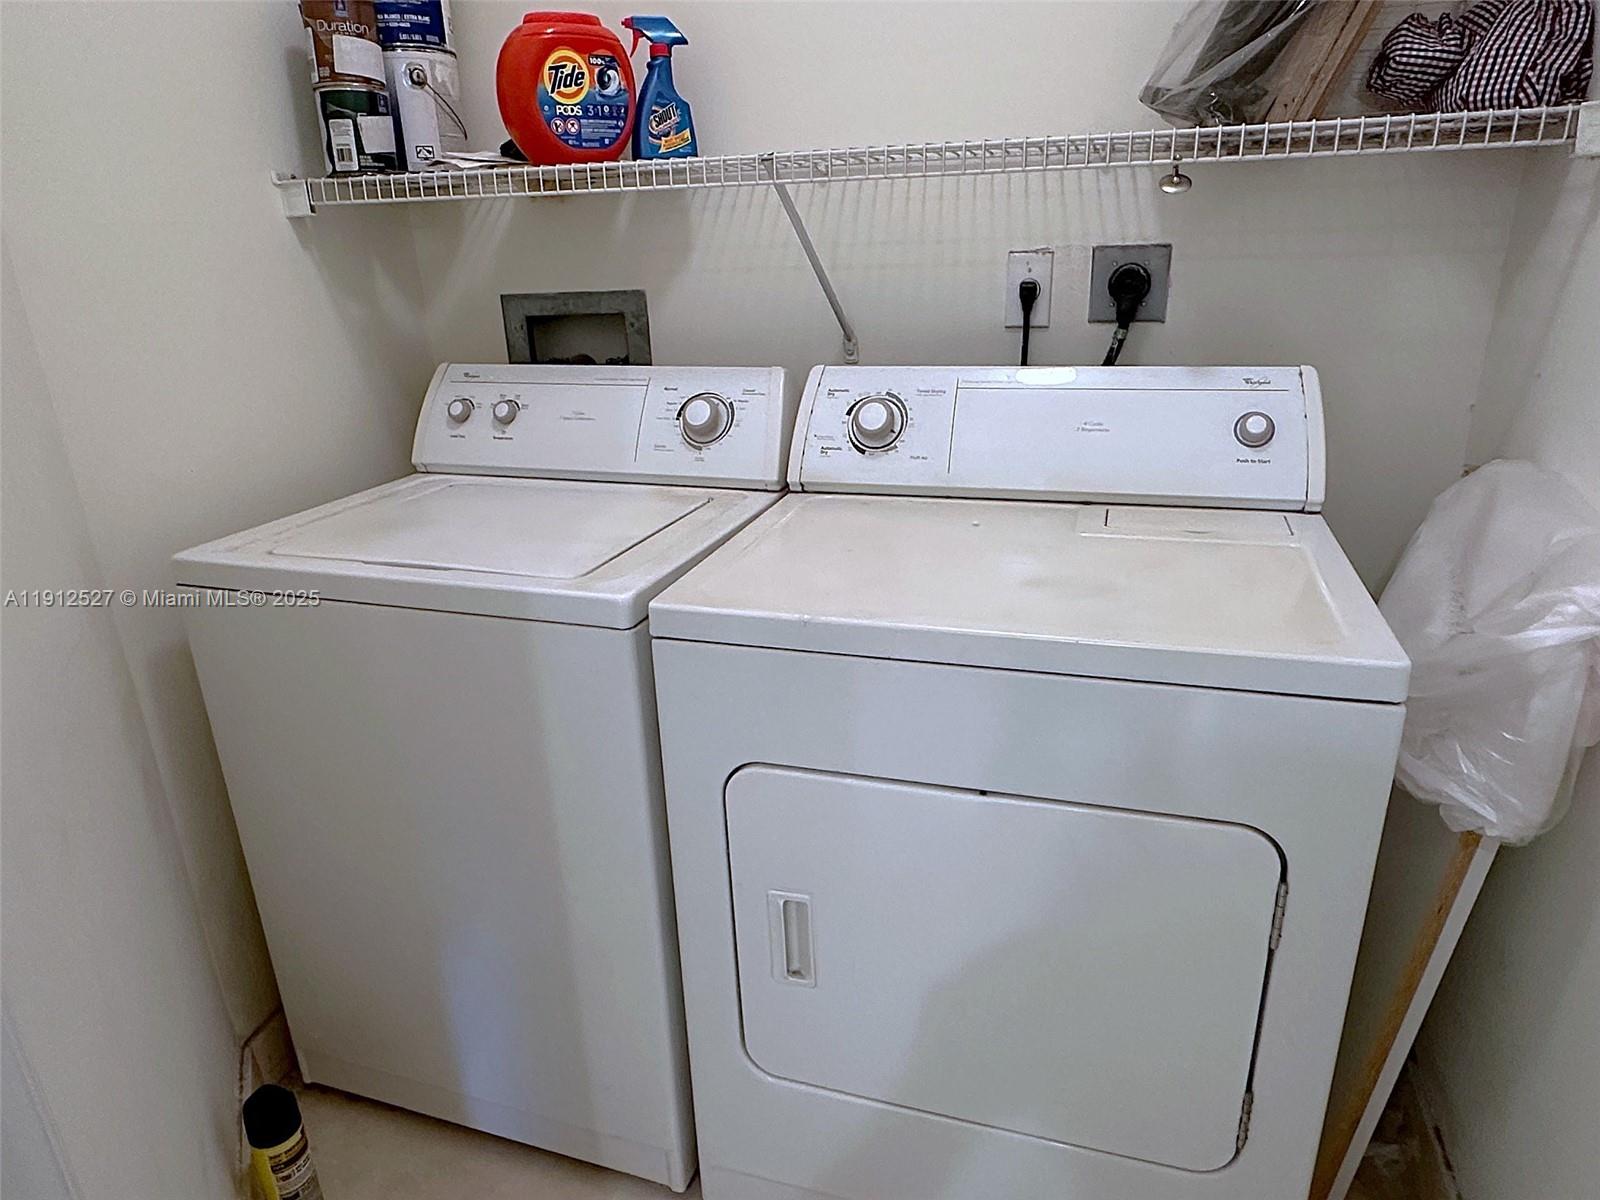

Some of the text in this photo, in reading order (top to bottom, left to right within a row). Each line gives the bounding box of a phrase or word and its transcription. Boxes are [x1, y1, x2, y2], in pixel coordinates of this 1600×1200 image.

[316, 19, 369, 33] Duration
[548, 63, 585, 94] Tide
[556, 104, 583, 116] PODS
[653, 104, 676, 128] SHOUT
